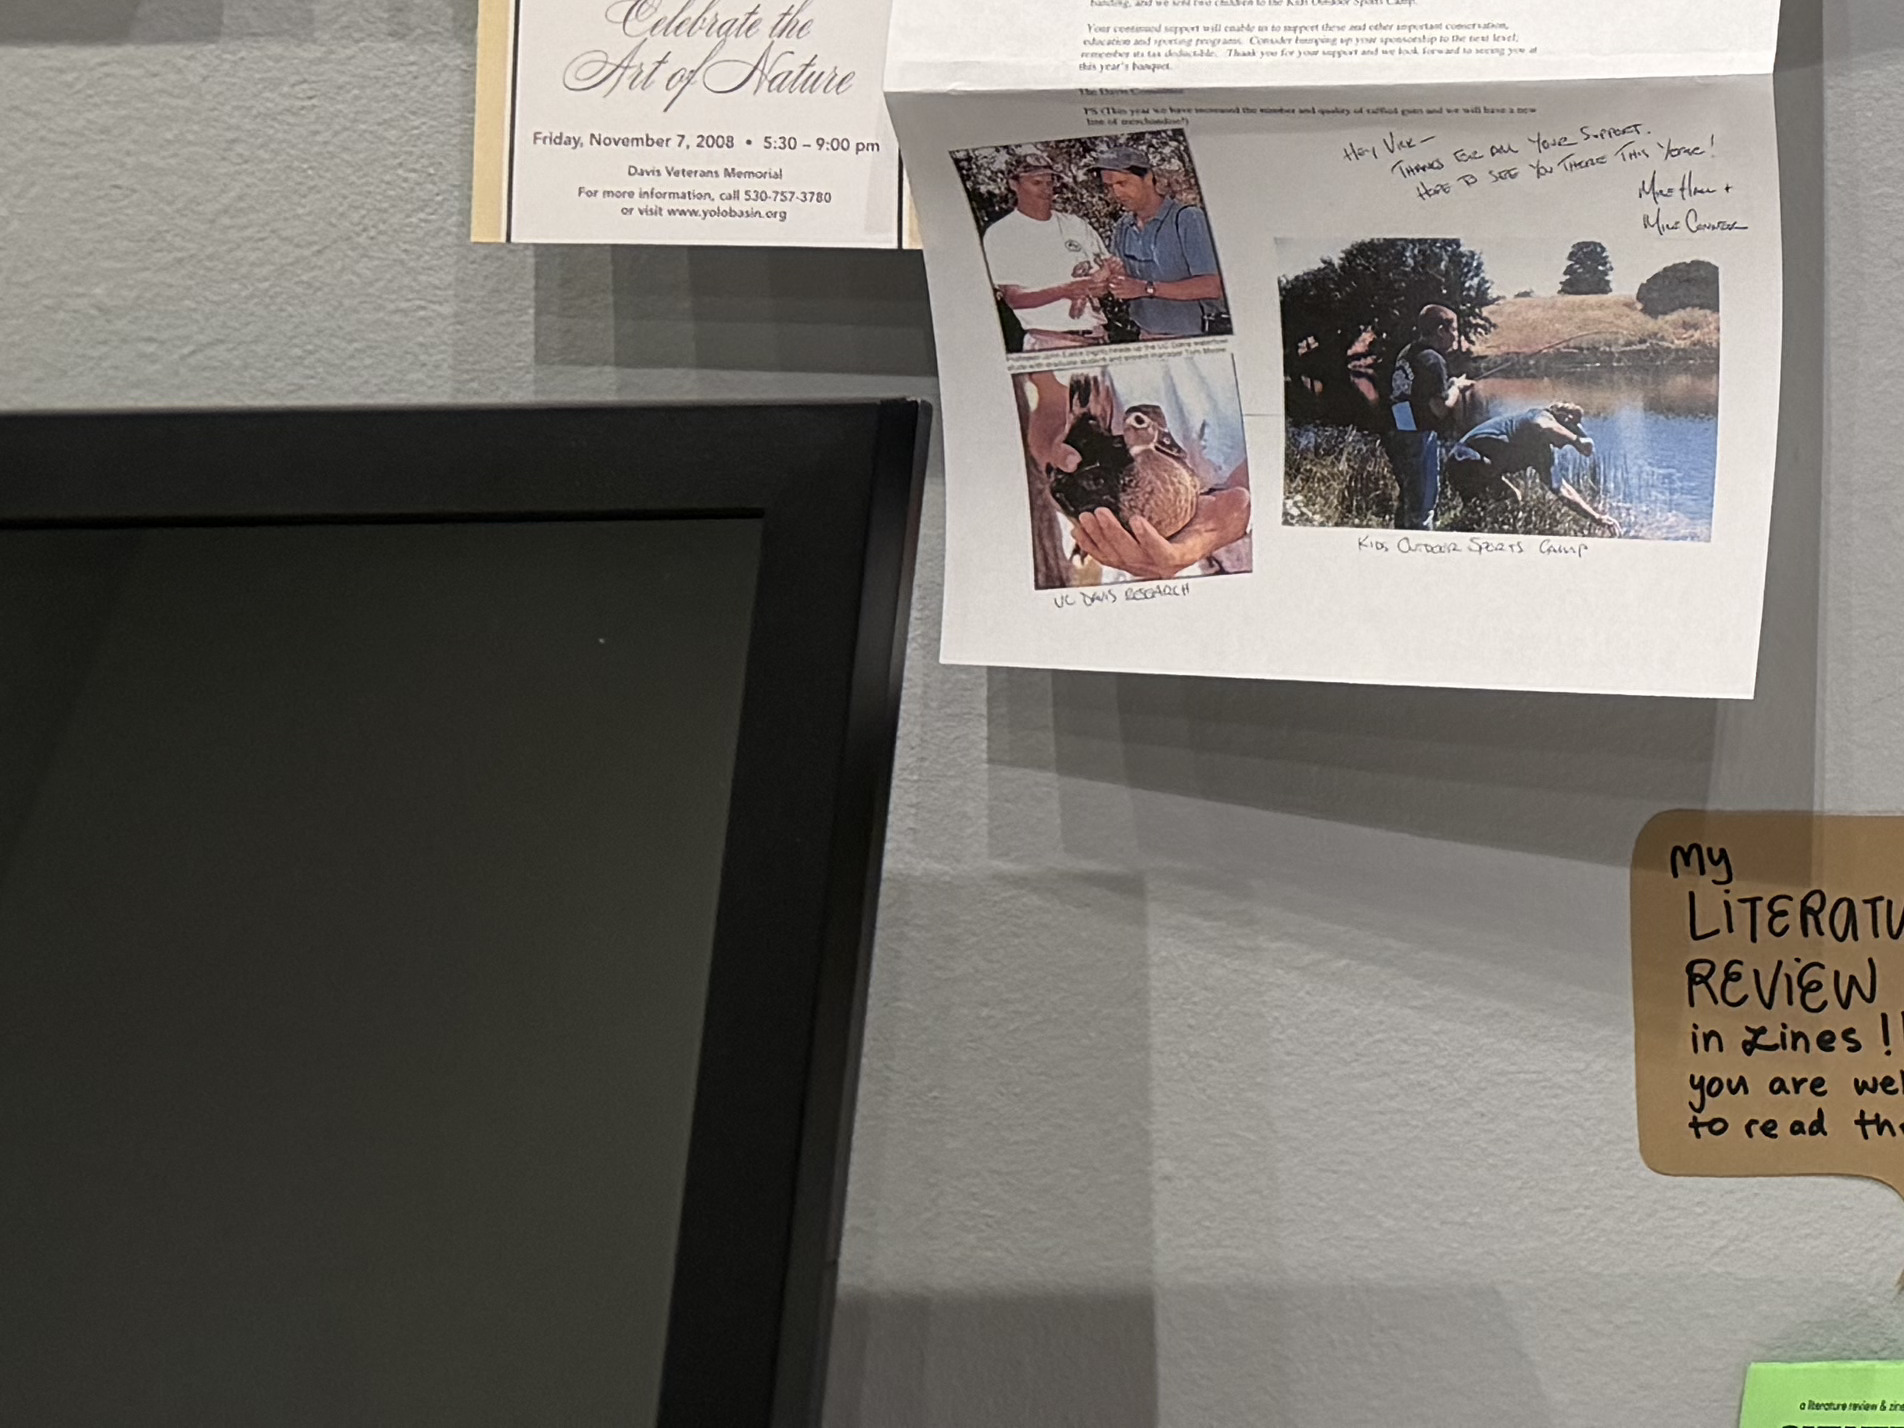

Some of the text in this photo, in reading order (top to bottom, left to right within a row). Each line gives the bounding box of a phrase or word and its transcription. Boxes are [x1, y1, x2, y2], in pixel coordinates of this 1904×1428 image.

[563, 38, 855, 112] Art of Nature
[533, 132, 879, 155] Friday, November 7, 2008 5:30 9:00 pm
[667, 206, 787, 222] www.yolobasin.org
